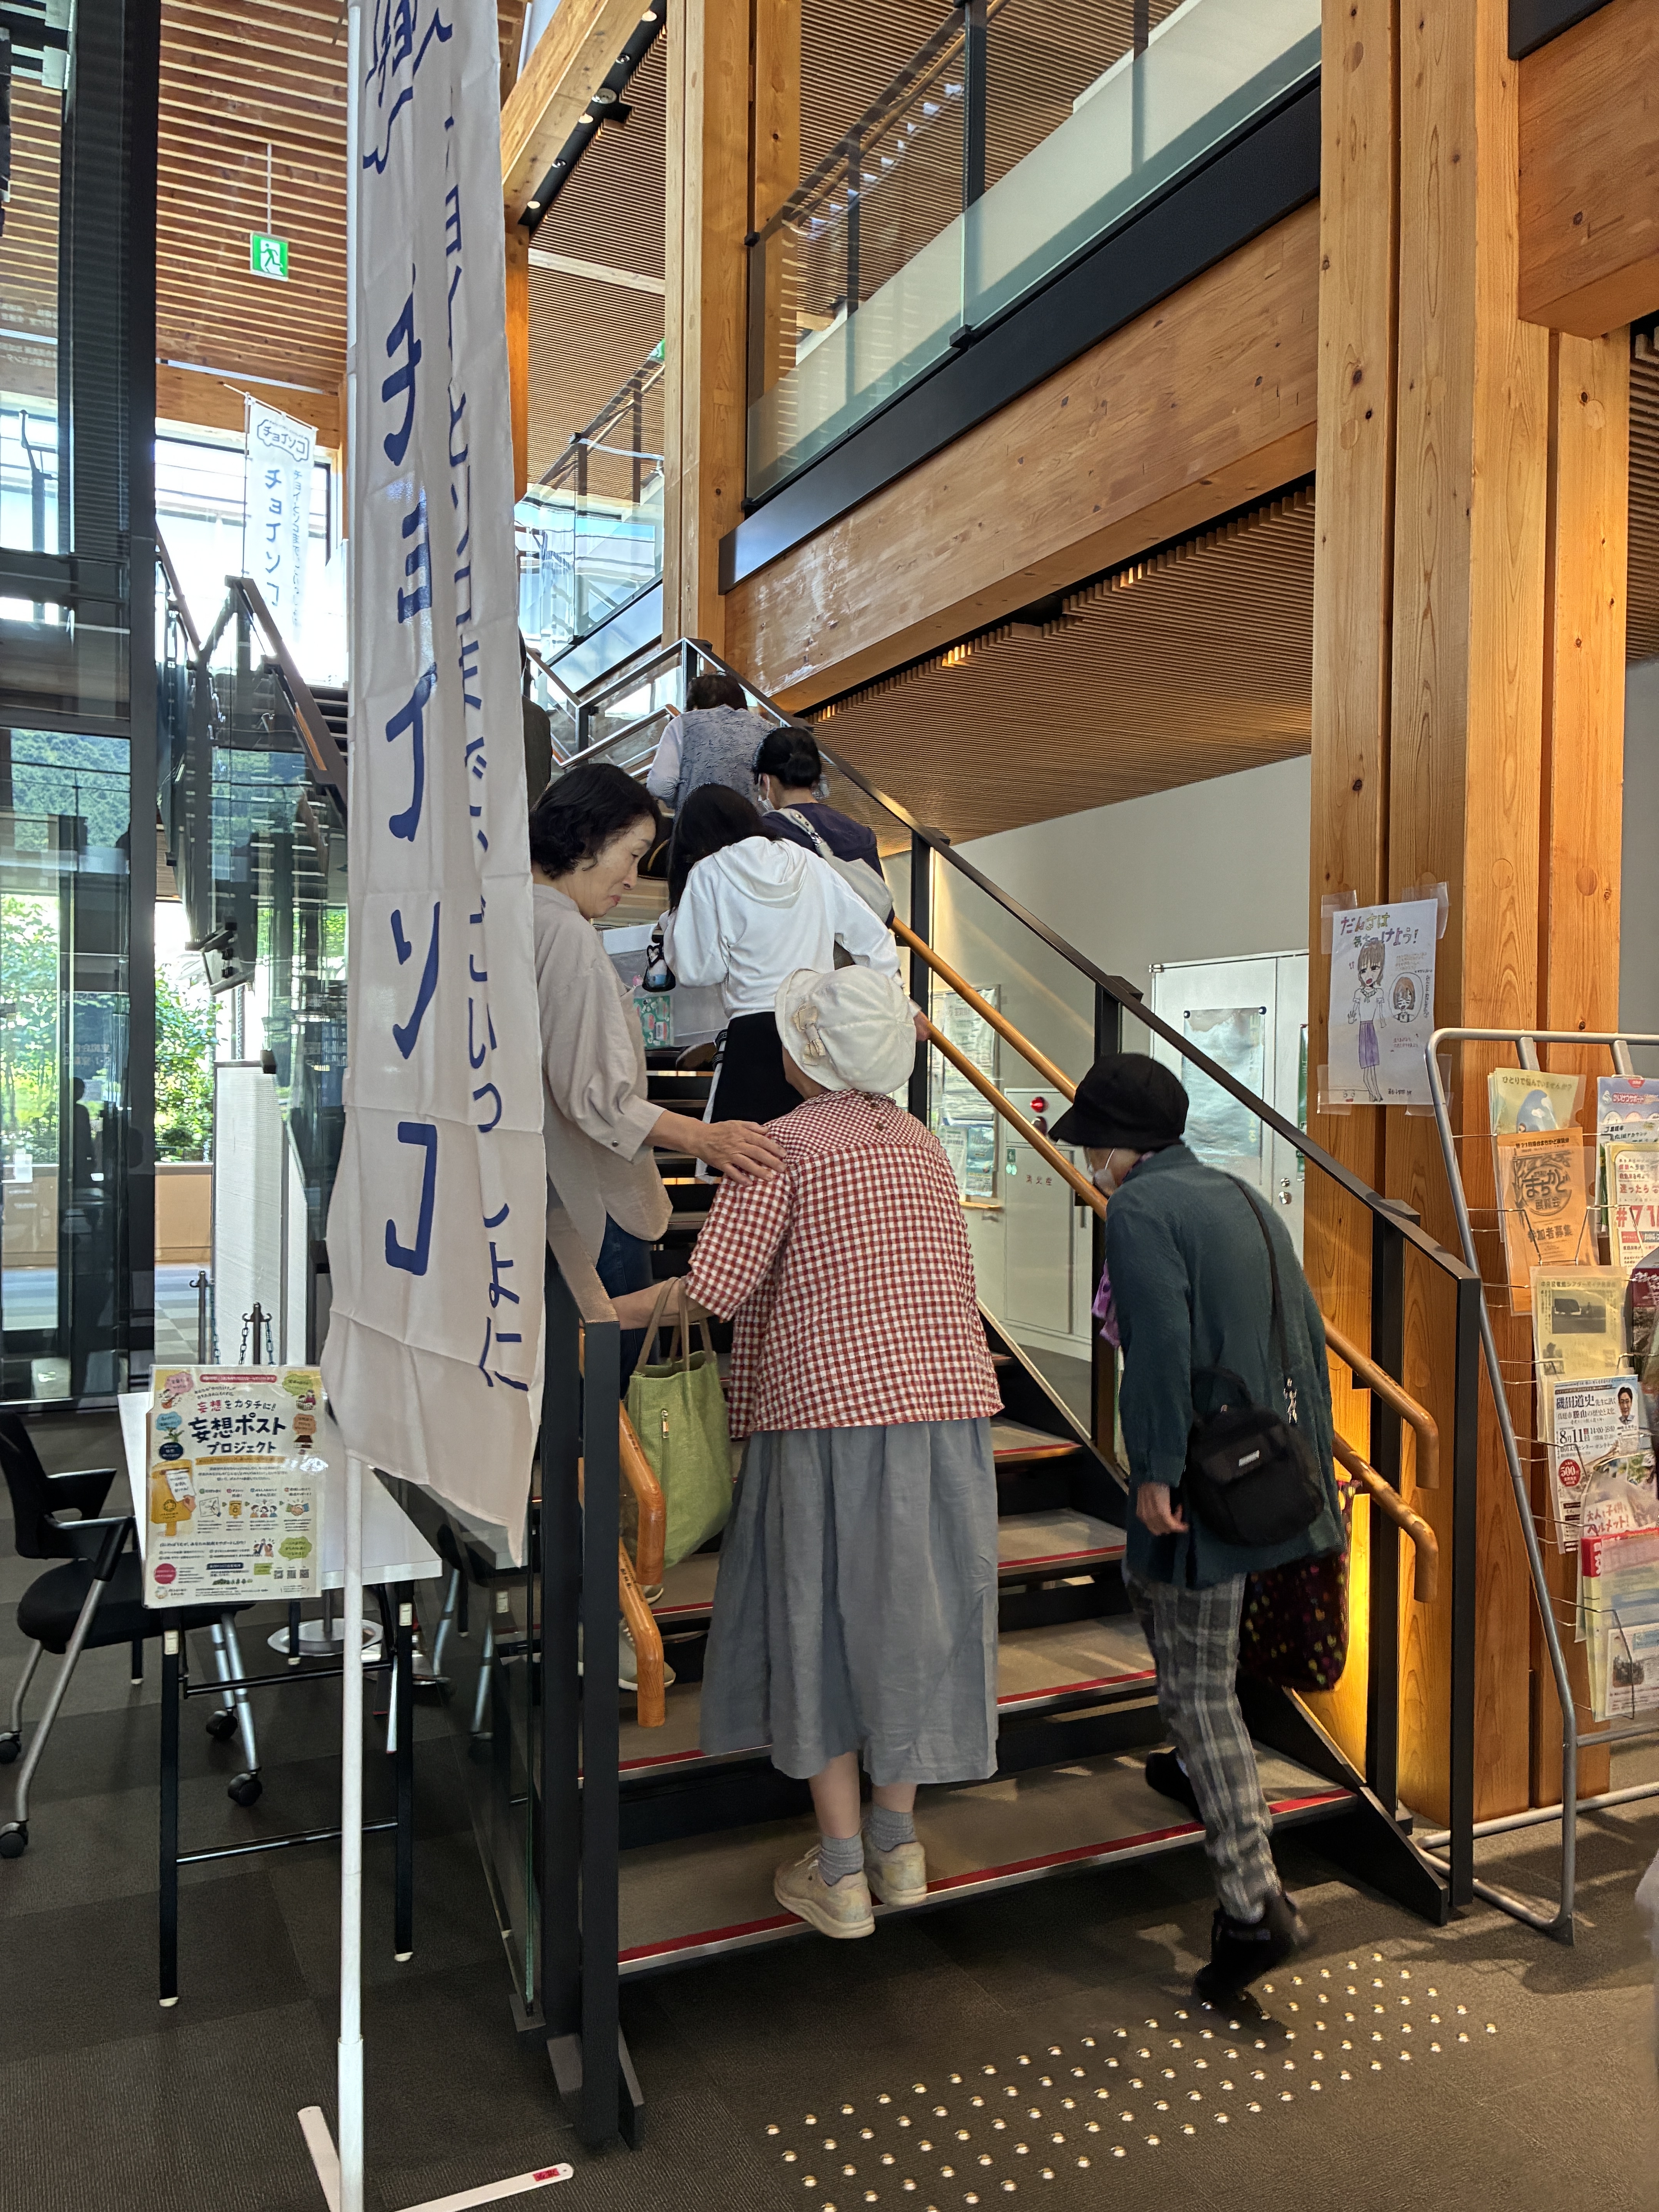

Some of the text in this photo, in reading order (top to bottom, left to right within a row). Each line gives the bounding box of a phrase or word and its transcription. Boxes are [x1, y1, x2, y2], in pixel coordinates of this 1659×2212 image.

[263, 426, 305, 454] チョイソコ
[265, 469, 282, 606] チョイソコ
[381, 263, 441, 1276] チョイソコ
[1026, 1175, 1052, 1185] 消火栓
[188, 1412, 287, 1443] 妄想ポスト
[207, 1441, 277, 1455] プロジェクト
